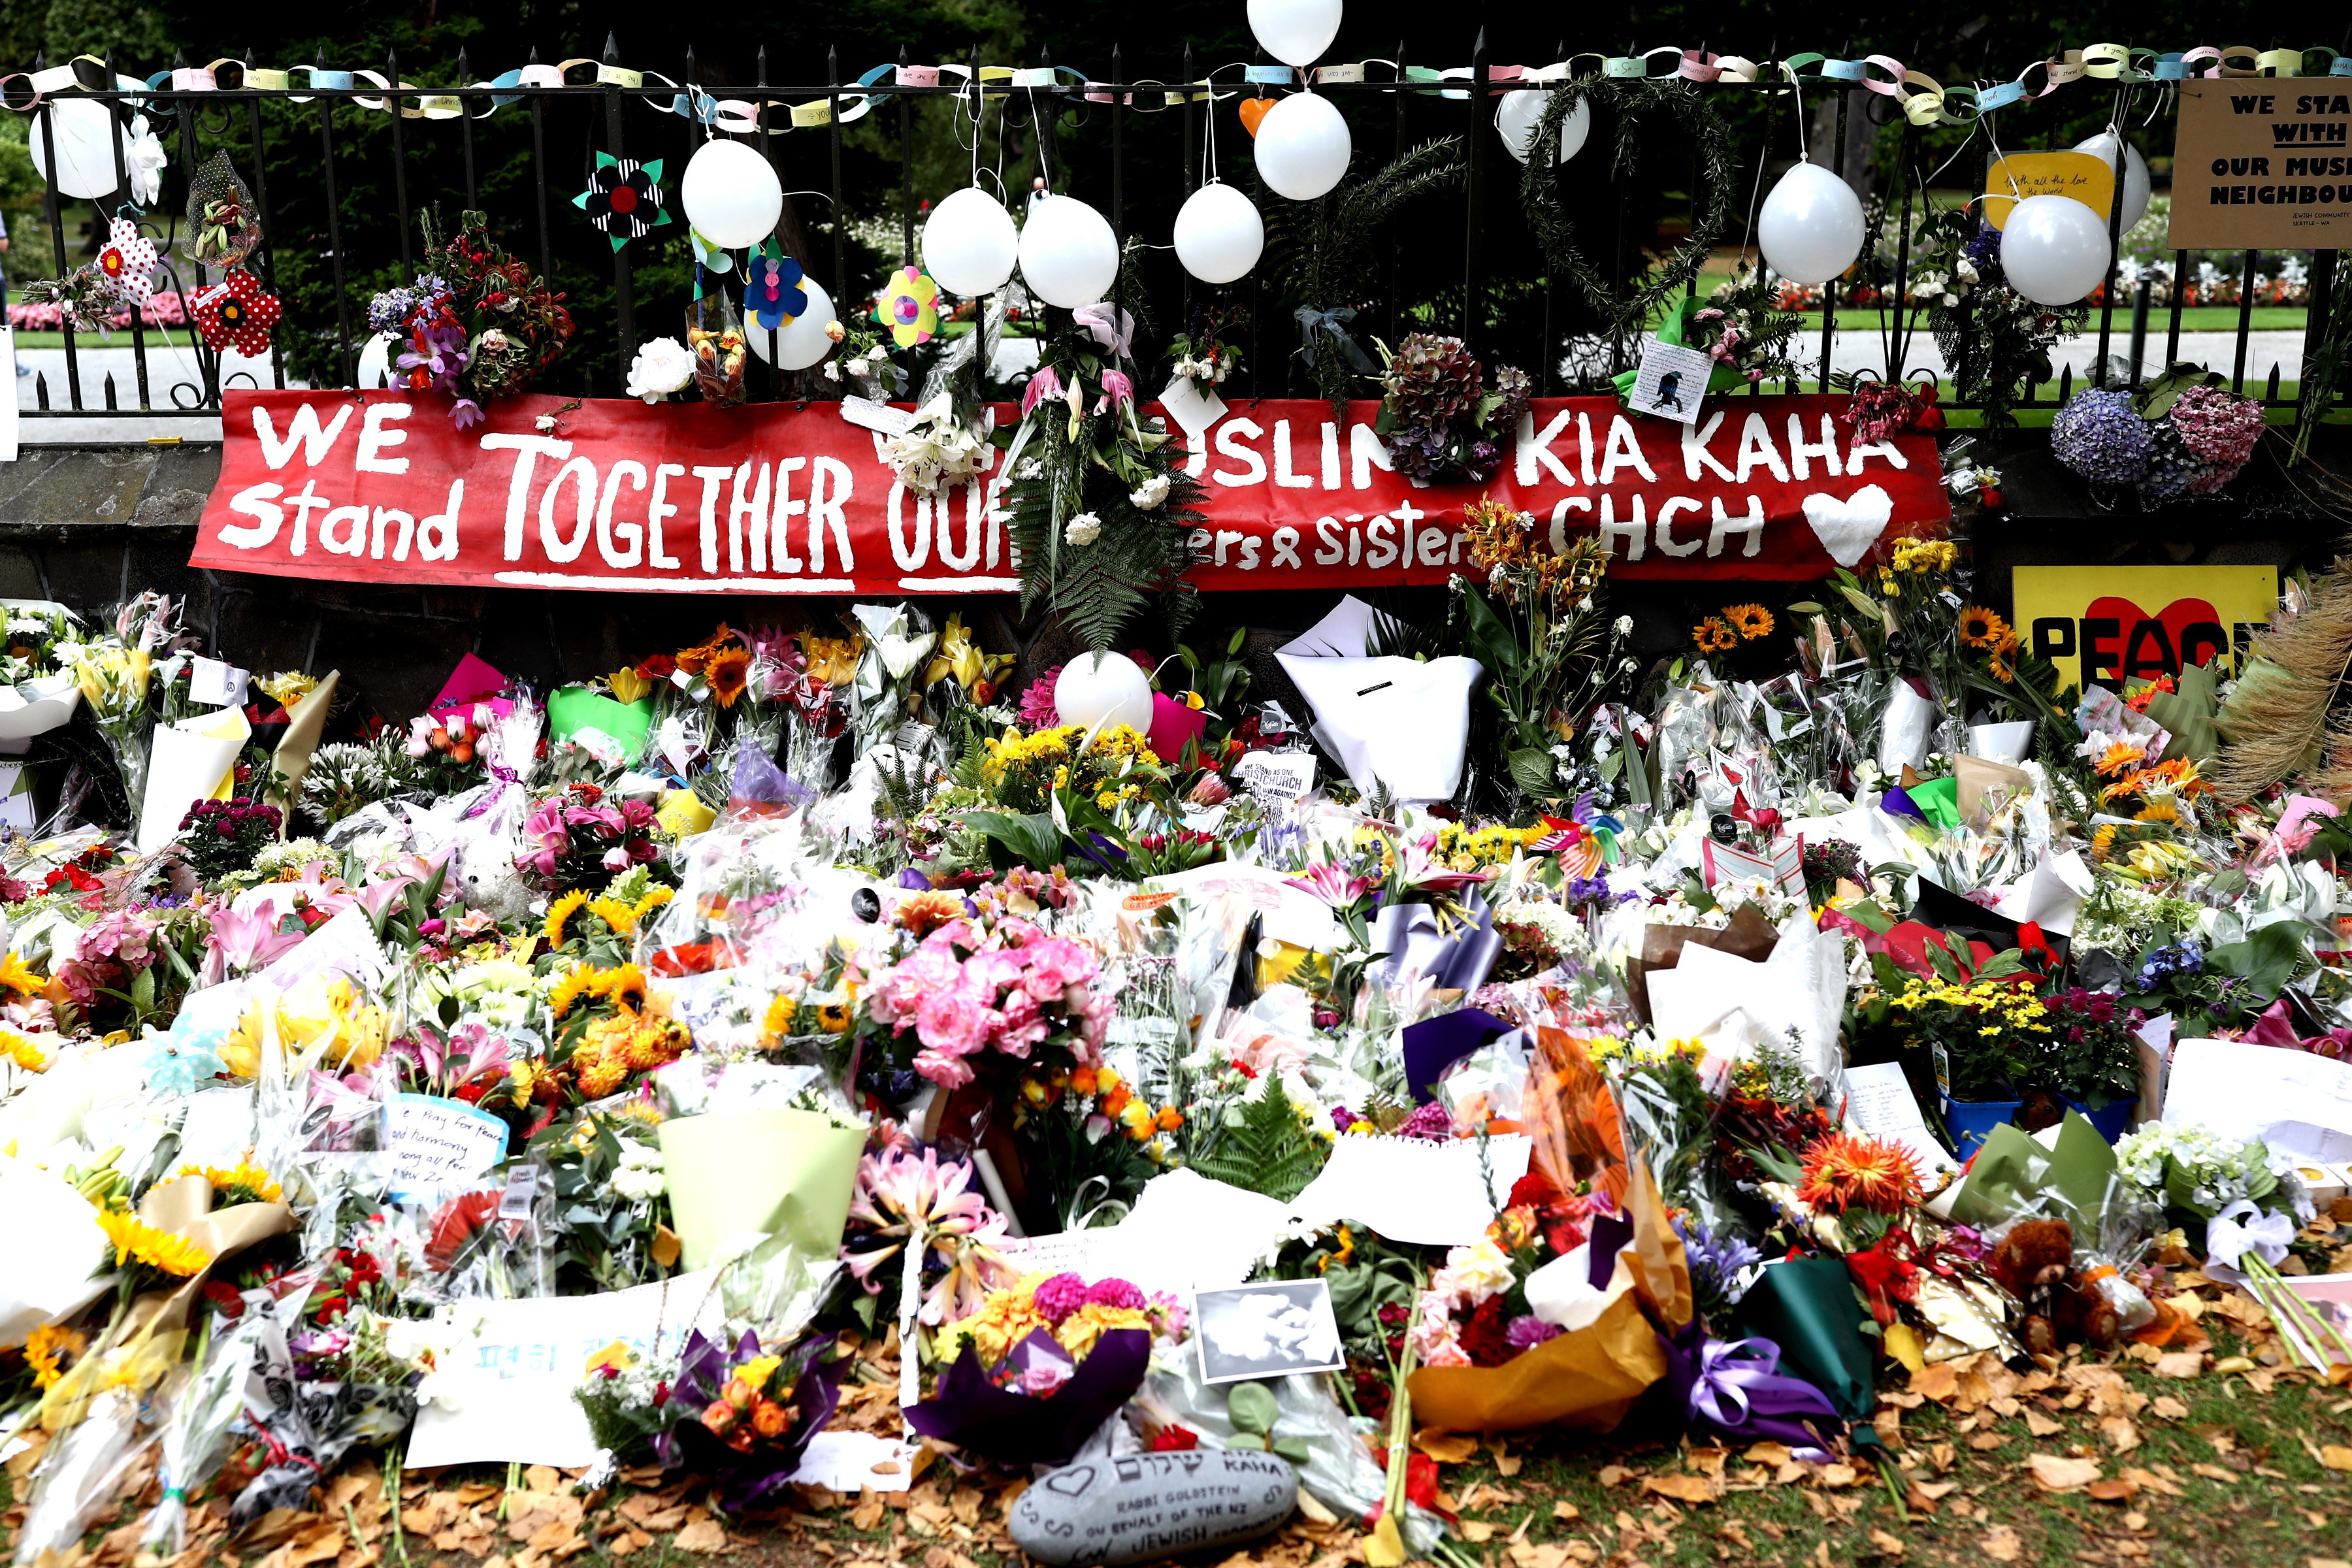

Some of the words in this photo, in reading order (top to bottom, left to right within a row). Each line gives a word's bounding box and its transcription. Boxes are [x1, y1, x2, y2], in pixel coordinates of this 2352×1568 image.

[2230, 95, 2276, 115] WE
[2296, 95, 2351, 115] STA
[2271, 123, 2347, 142] WITH
[2211, 157, 2270, 176] OUR
[2027, 187, 2037, 195] the
[2034, 176, 2048, 186] all
[2051, 174, 2065, 185] the
[2070, 173, 2088, 185] love
[252, 402, 414, 475] WE
[1514, 408, 1658, 488] KIA
[1681, 410, 1909, 484] KAHA
[480, 432, 855, 575] TOGETHER
[216, 478, 465, 562] Stand
[1548, 492, 1765, 562] CHCH
[1270, 525, 1303, 570] &
[1233, 769, 1302, 791] CHRISTCHURCH
[1255, 763, 1272, 776] STAND
[1281, 768, 1294, 777] ONE
[1273, 789, 1296, 800] AGAINST
[410, 1128, 468, 1160] harmony
[426, 1155, 444, 1166] all
[1224, 1459, 1282, 1478] KAHA
[1117, 1496, 1159, 1514] RABBI
[1165, 1484, 1241, 1503] GOLDSTEIN
[1086, 1525, 1106, 1539] ON
[1111, 1512, 1163, 1535] BEHALF
[1170, 1509, 1189, 1524] OF
[1196, 1504, 1224, 1519] THE
[1131, 1526, 1208, 1555] JEWISH
